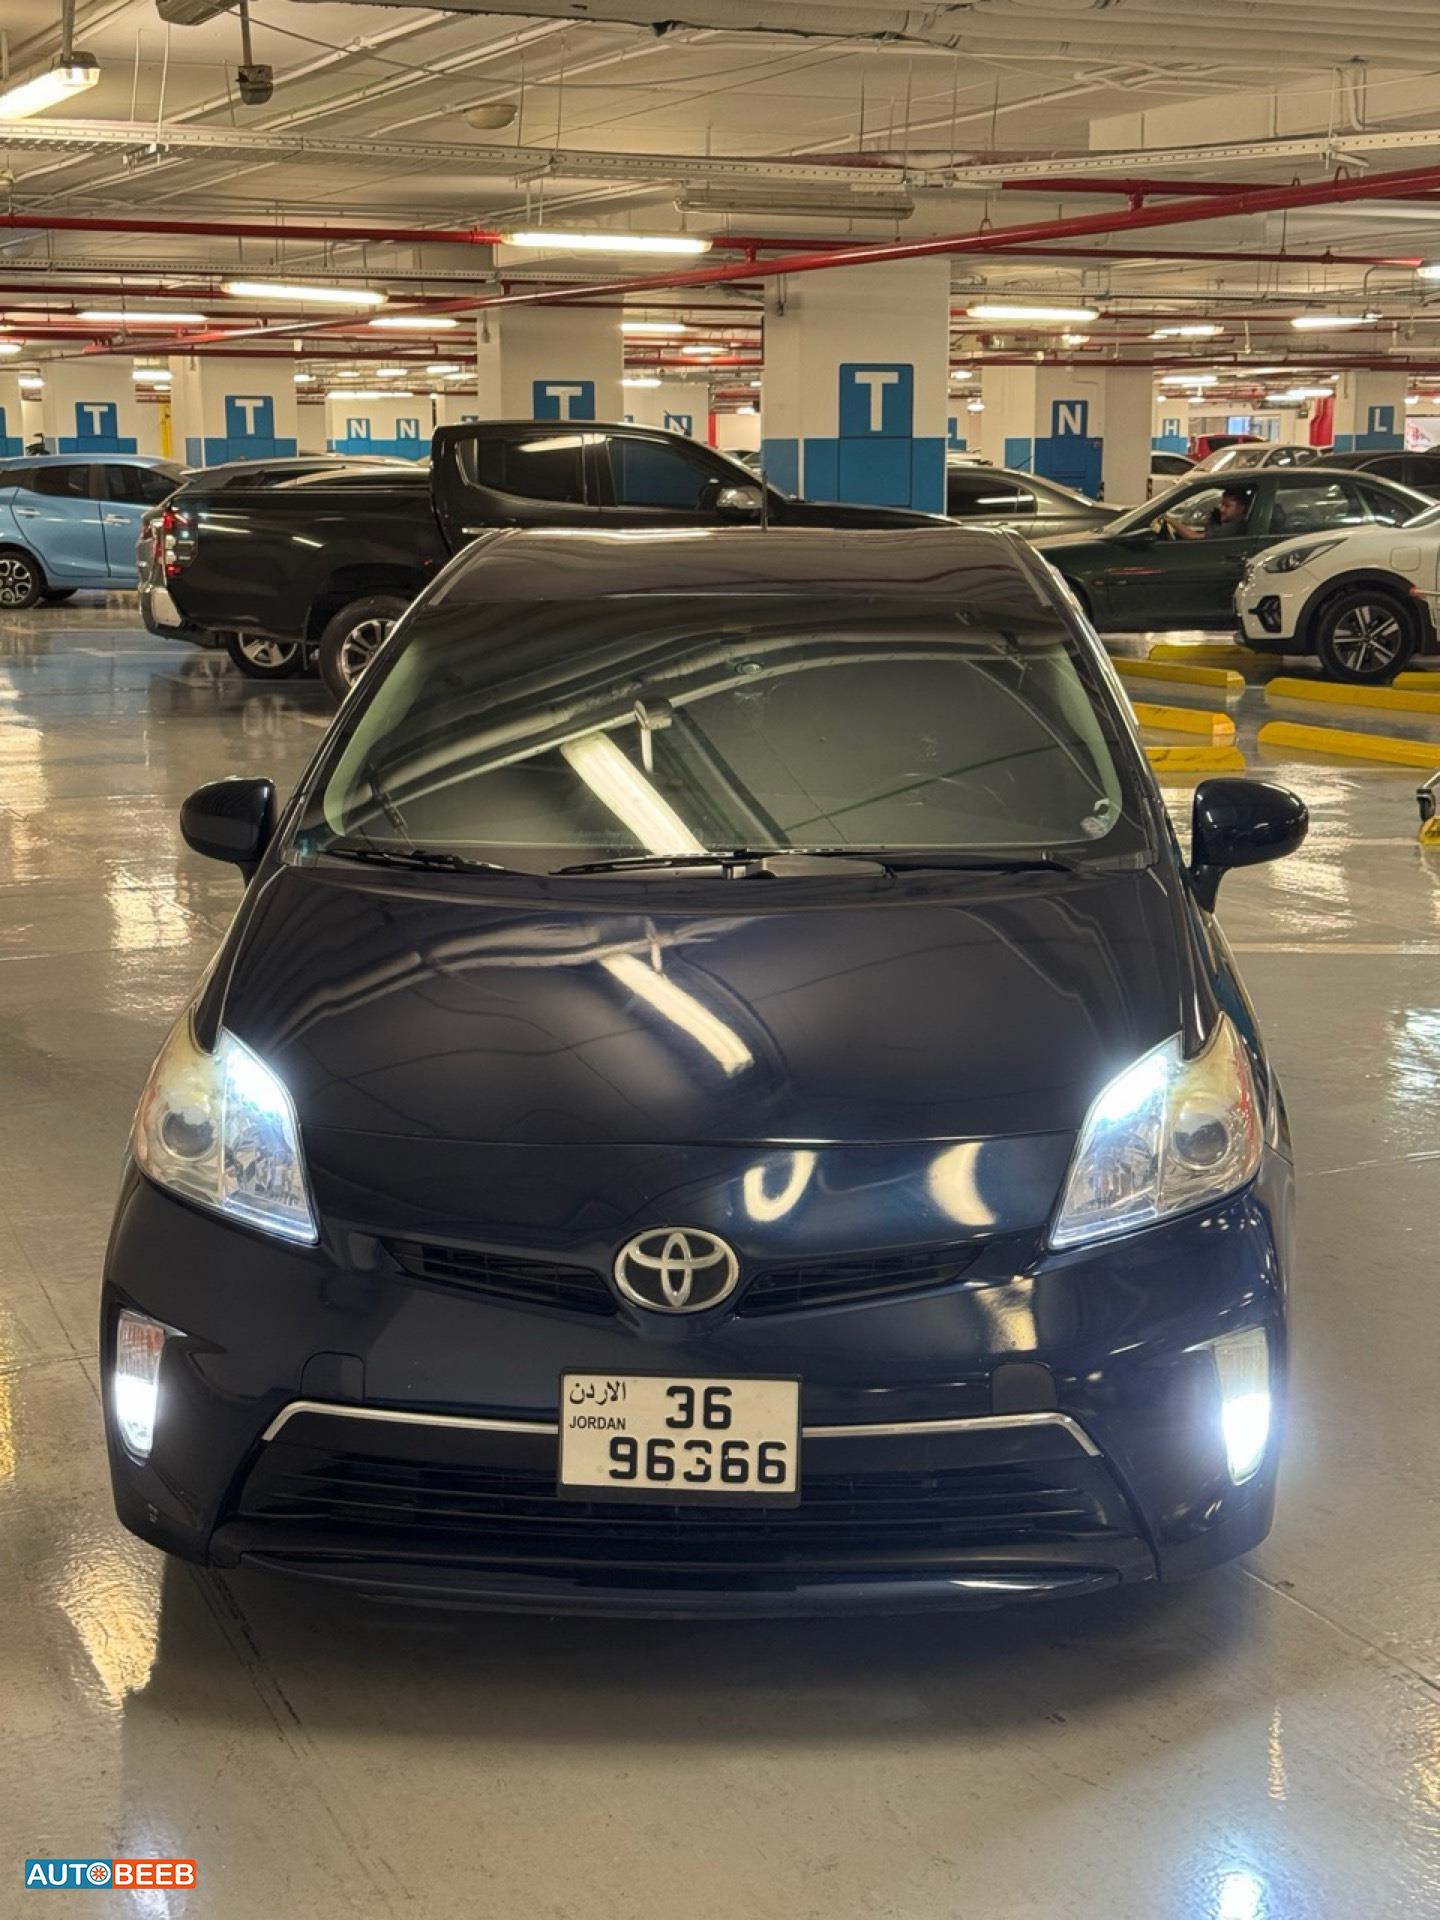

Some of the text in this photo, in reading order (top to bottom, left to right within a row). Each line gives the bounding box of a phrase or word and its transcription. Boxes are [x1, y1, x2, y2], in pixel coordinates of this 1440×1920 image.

[546, 386, 583, 421] T
[854, 371, 899, 432] T
[84, 405, 108, 435] T
[234, 399, 263, 435] T
[351, 420, 366, 437] N
[400, 419, 414, 437] N
[1058, 404, 1082, 435] N
[1165, 420, 1178, 435] H
[1374, 408, 1387, 432] L
[568, 1380, 628, 1405] الاردن
[665, 1385, 733, 1429] 36
[568, 1415, 627, 1431] JORDAN
[608, 1436, 788, 1484] 96366
